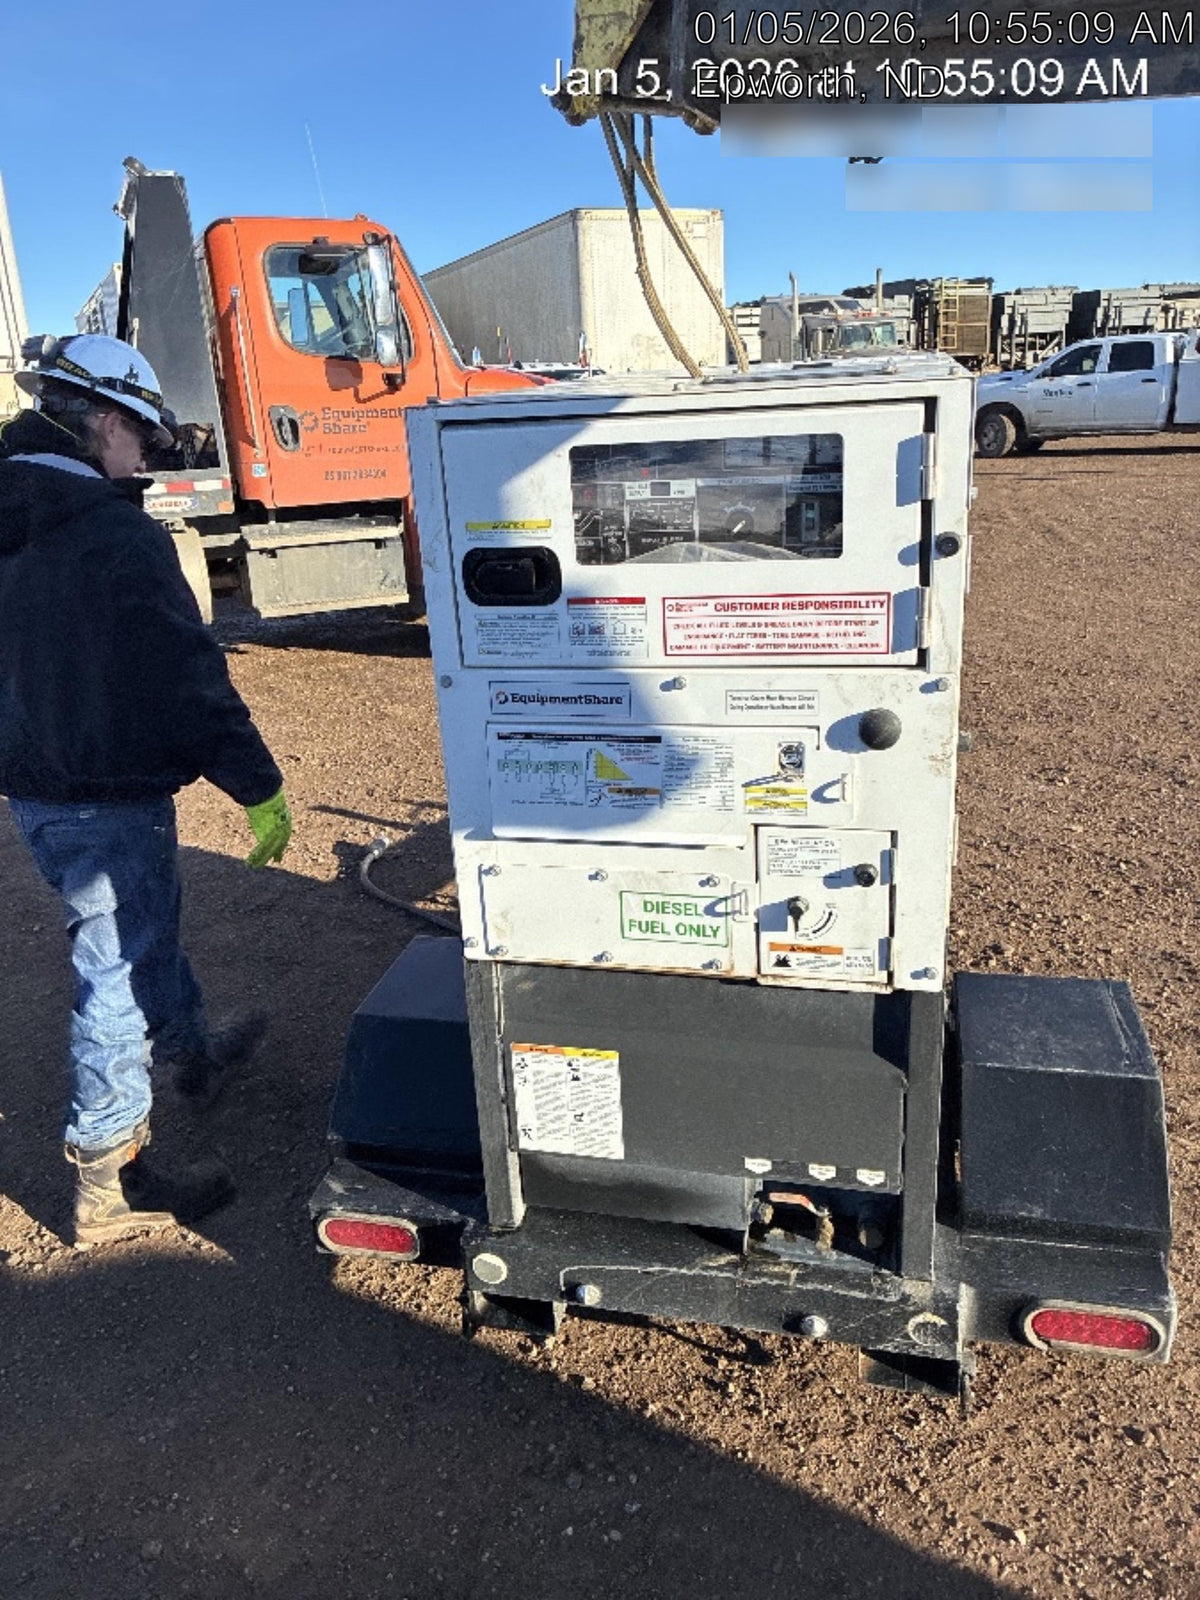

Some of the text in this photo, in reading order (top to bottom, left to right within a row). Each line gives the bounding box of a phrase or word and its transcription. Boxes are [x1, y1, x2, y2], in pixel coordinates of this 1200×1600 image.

[321, 406, 404, 422] Equipment
[323, 422, 368, 435] Share
[714, 601, 780, 613] CUSTOMER
[782, 600, 886, 611] RESPONSIBILITY
[510, 689, 624, 706] EquipmentShare
[643, 899, 704, 917] DIESEL
[628, 918, 720, 938] FUEL ONLY
